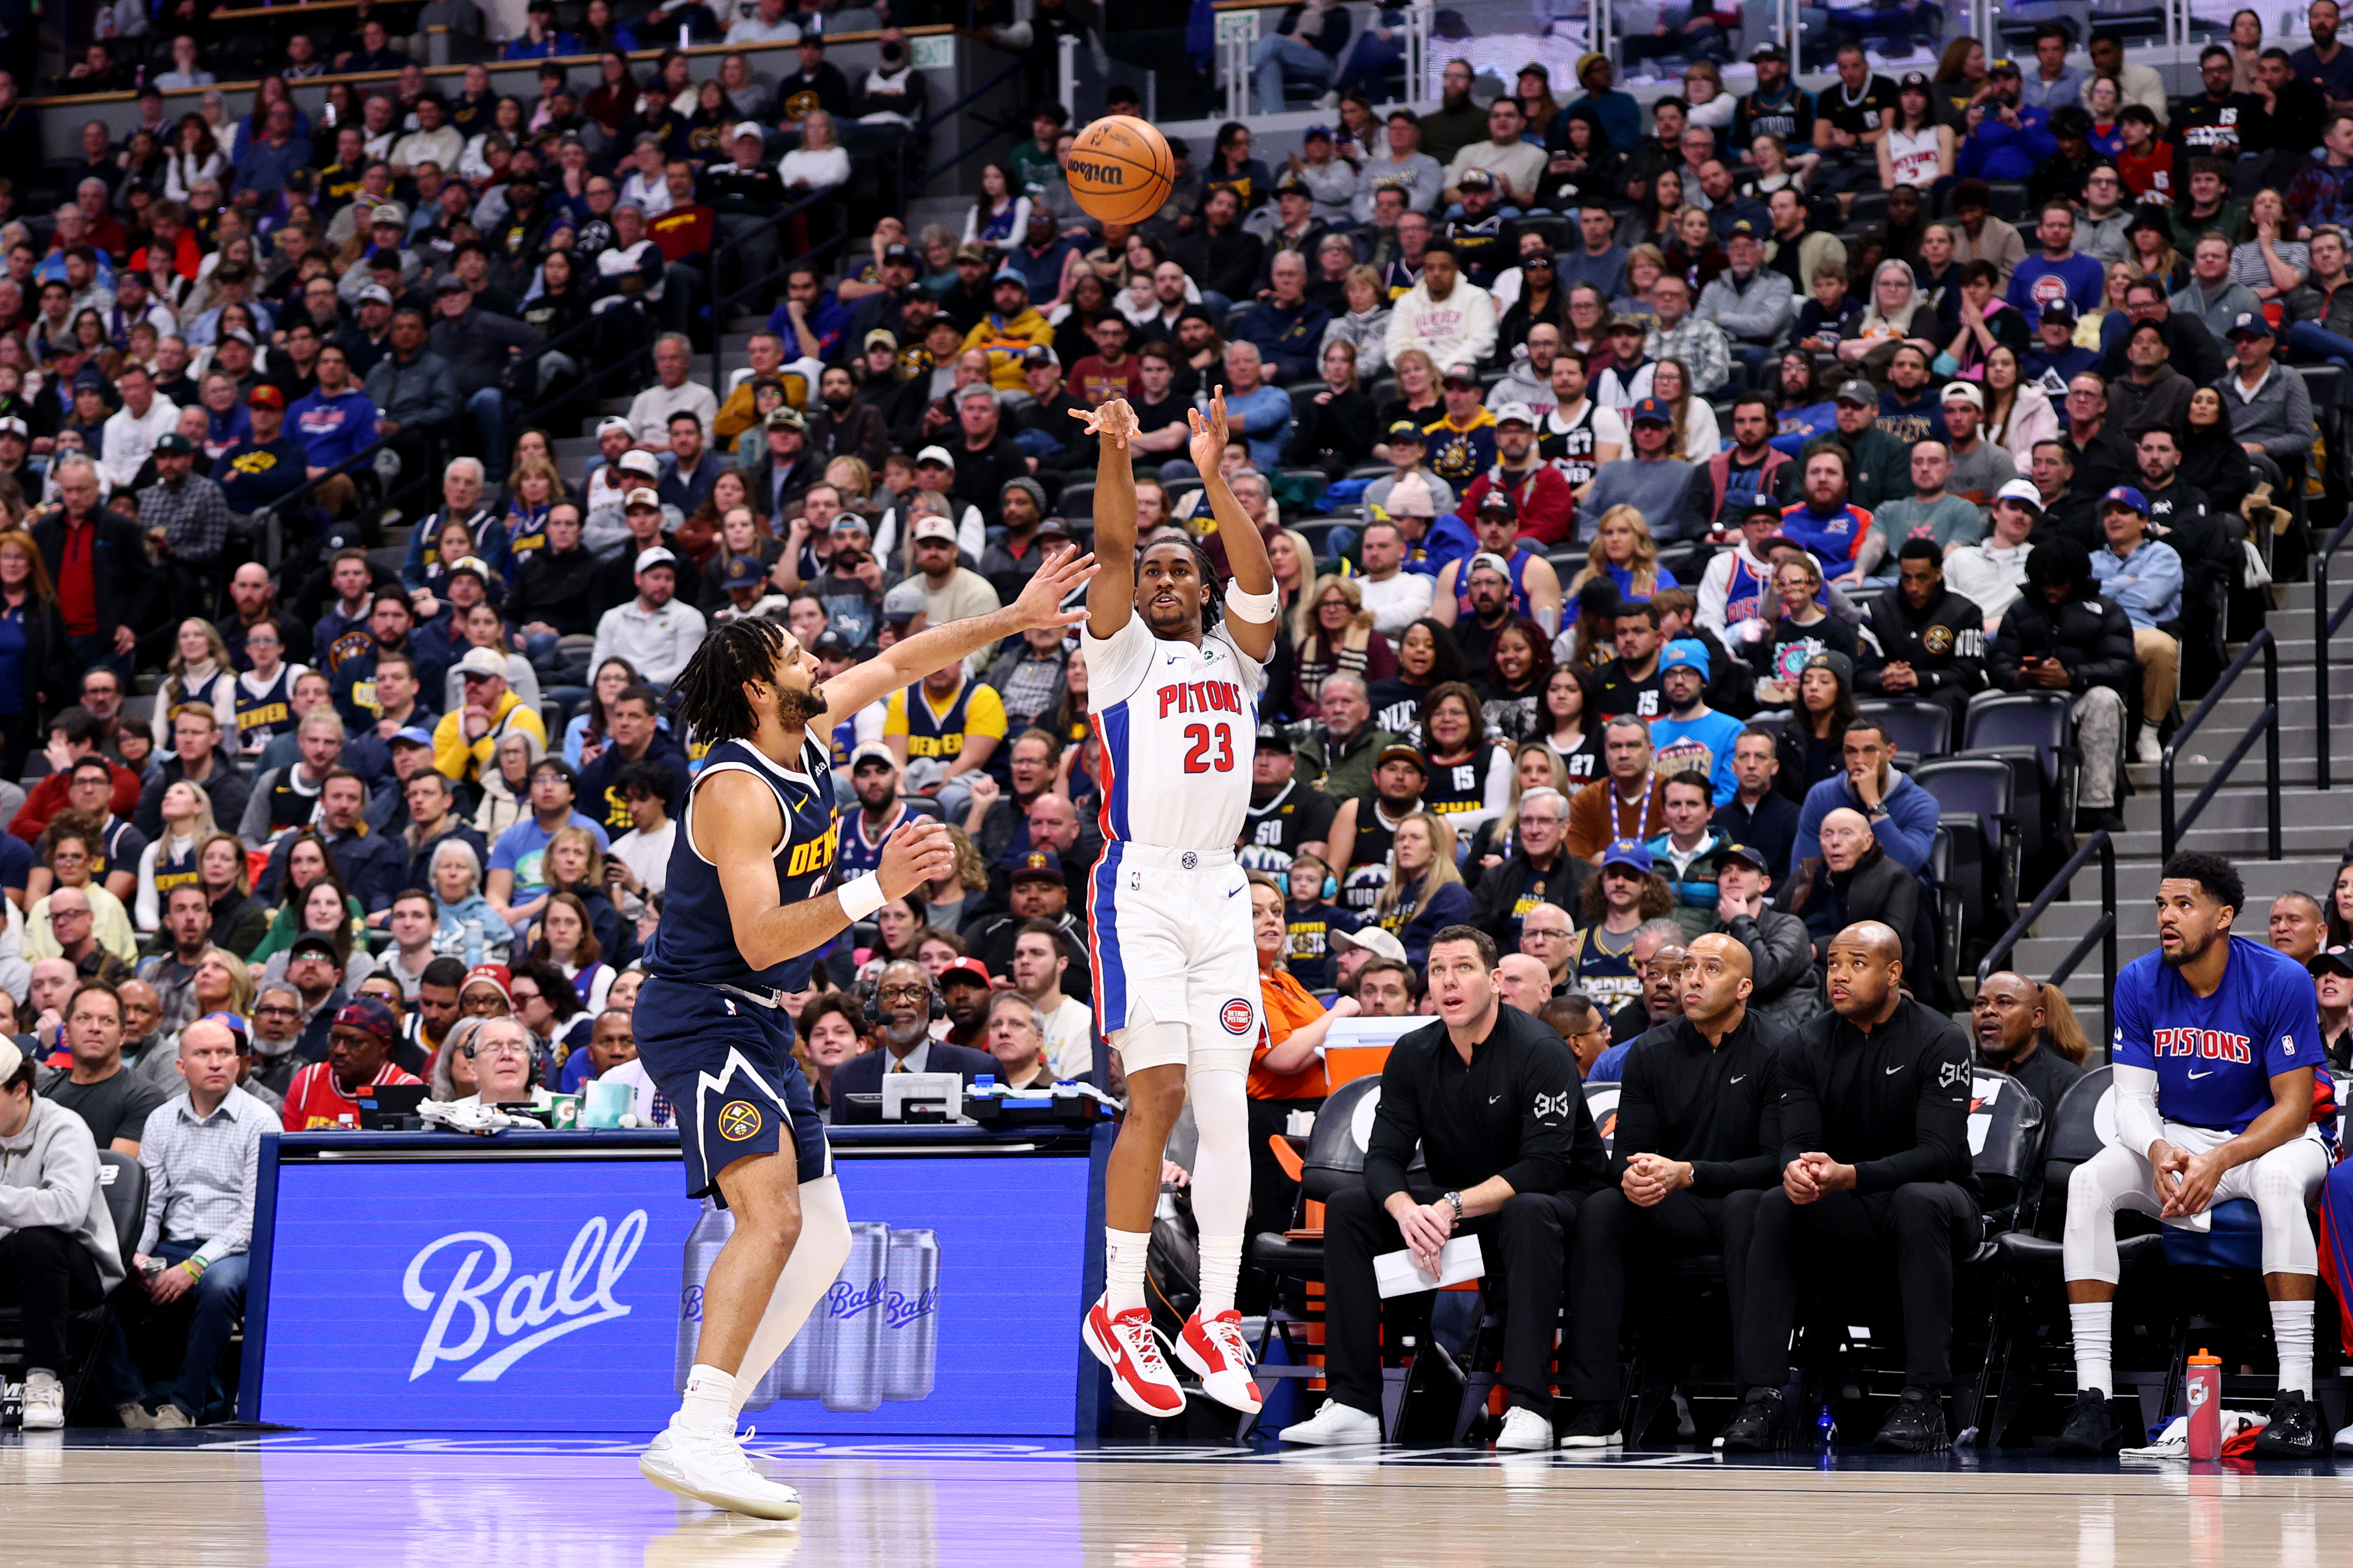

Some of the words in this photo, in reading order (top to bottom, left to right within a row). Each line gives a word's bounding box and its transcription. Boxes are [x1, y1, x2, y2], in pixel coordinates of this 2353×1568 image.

[1067, 158, 1123, 185] Wilson
[1156, 680, 1242, 720] PISTONS
[1636, 690, 1659, 716] 15
[908, 733, 963, 758] DENVER
[1183, 723, 1234, 774] 23
[1451, 765, 1475, 791] 15
[1569, 754, 1595, 777] 27
[2153, 1027, 2252, 1064] PISTONS
[1938, 1057, 1970, 1088] 313
[1533, 1090, 1569, 1119] 313
[403, 1209, 648, 1382] Ball
[829, 1277, 887, 1319] Ball
[887, 1285, 938, 1329] Ball
